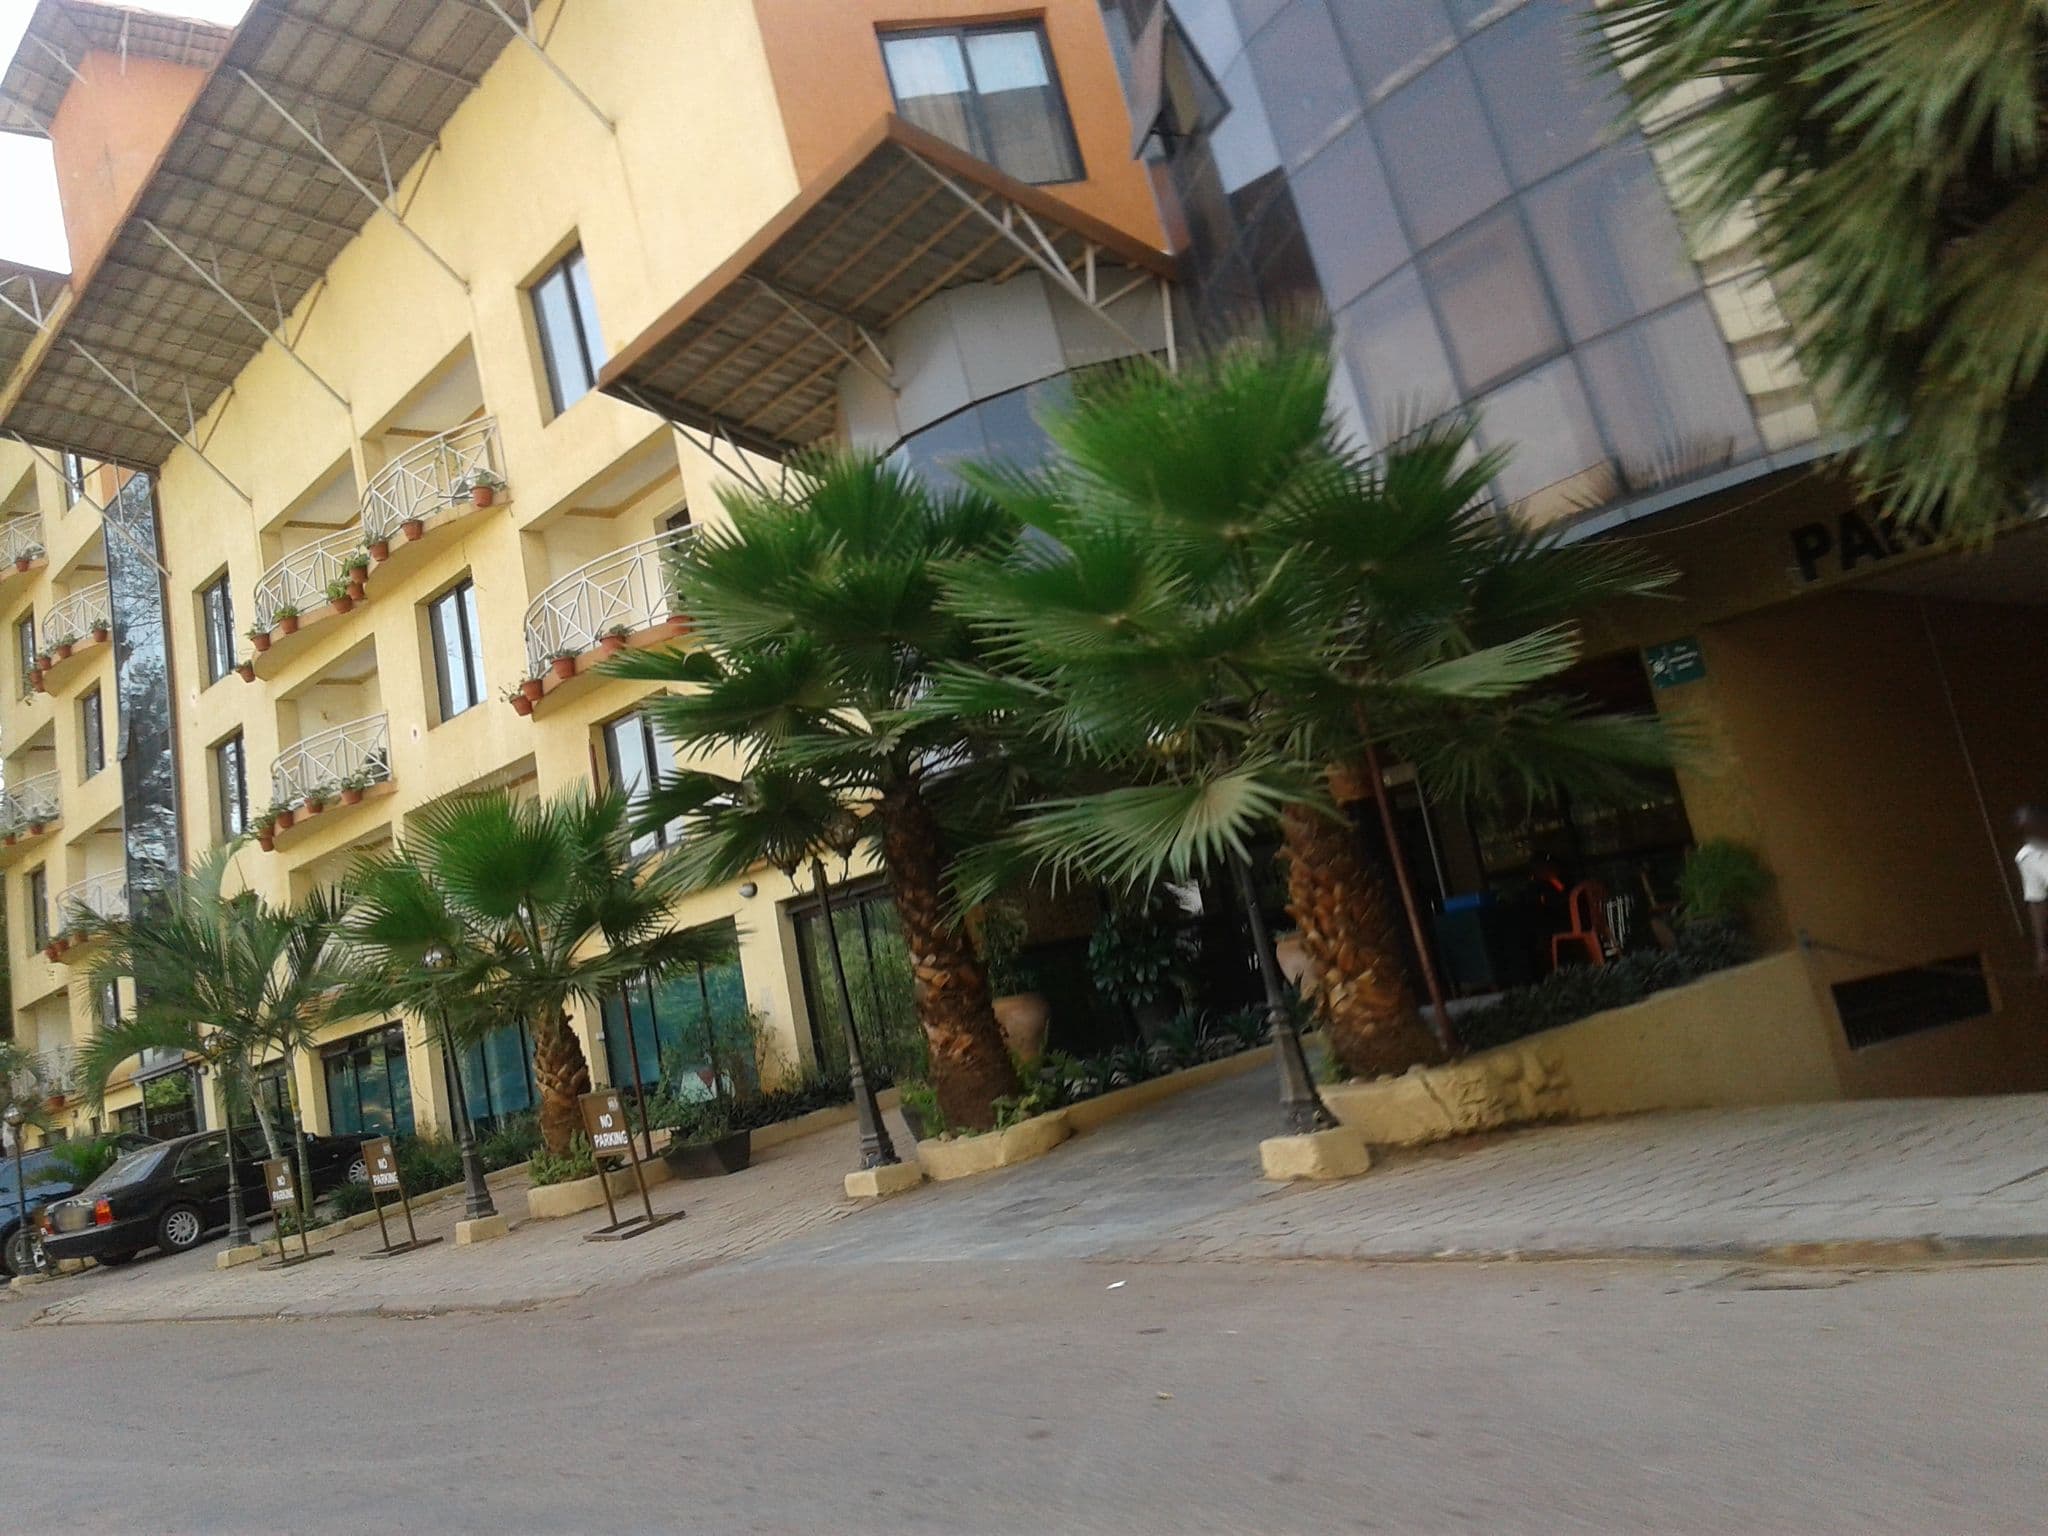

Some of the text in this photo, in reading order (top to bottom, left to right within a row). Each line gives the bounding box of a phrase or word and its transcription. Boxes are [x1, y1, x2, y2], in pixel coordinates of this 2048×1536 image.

[599, 1113, 613, 1128] NO
[593, 1130, 628, 1149] PARKING
[377, 1157, 388, 1170] NO
[276, 1174, 286, 1187] NO
[372, 1171, 399, 1186] PARKING
